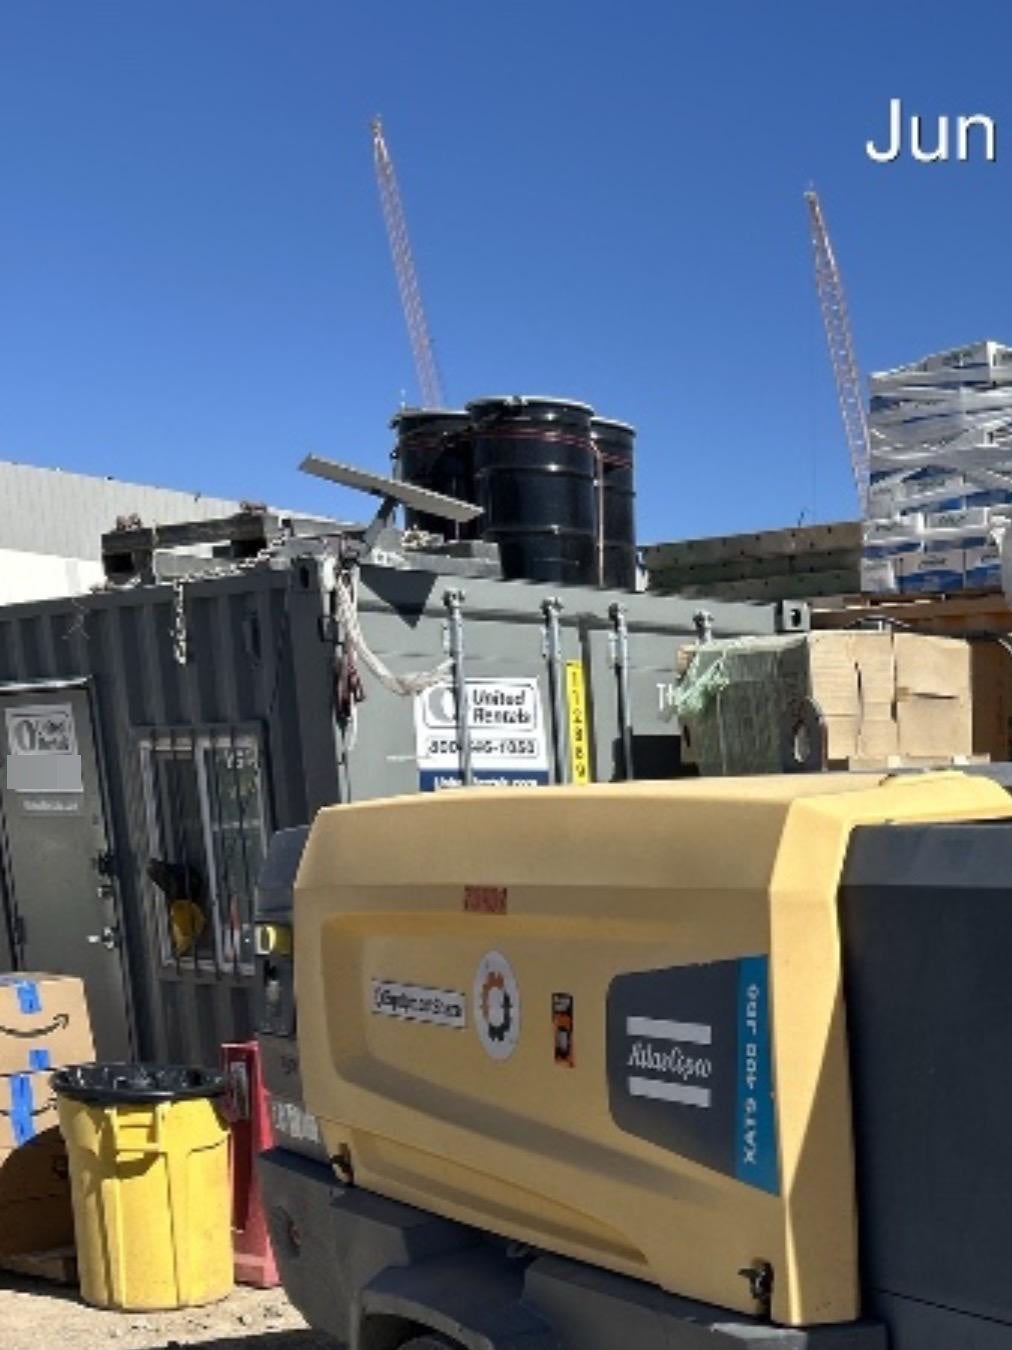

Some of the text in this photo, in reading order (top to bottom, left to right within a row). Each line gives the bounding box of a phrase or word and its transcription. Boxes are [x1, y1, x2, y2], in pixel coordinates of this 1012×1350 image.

[472, 688, 526, 706] United
[472, 707, 532, 724] Rentals
[744, 1041, 758, 1091] 400
